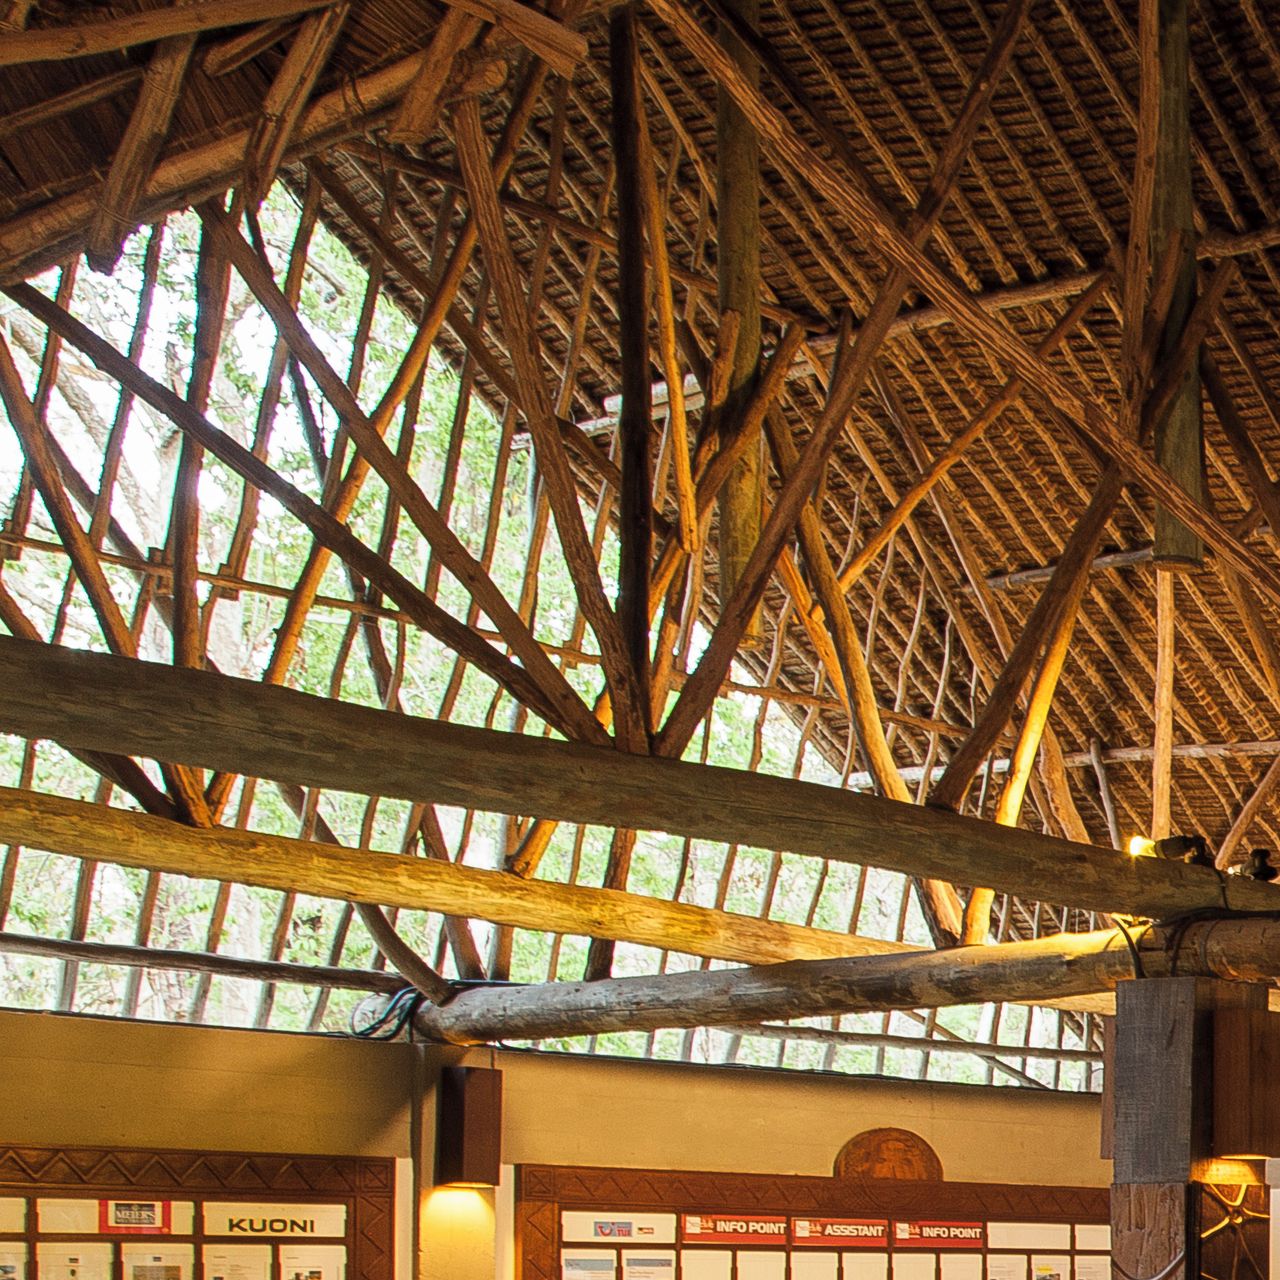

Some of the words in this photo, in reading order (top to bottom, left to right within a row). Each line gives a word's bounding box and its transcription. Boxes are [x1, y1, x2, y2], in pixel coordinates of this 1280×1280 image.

[228, 1218, 315, 1233] KUONI
[716, 1220, 747, 1233] INFO
[748, 1221, 787, 1234] POINT
[824, 1224, 884, 1237] ASSISTANT
[922, 1226, 948, 1238] INFO
[949, 1227, 982, 1239] POINT
